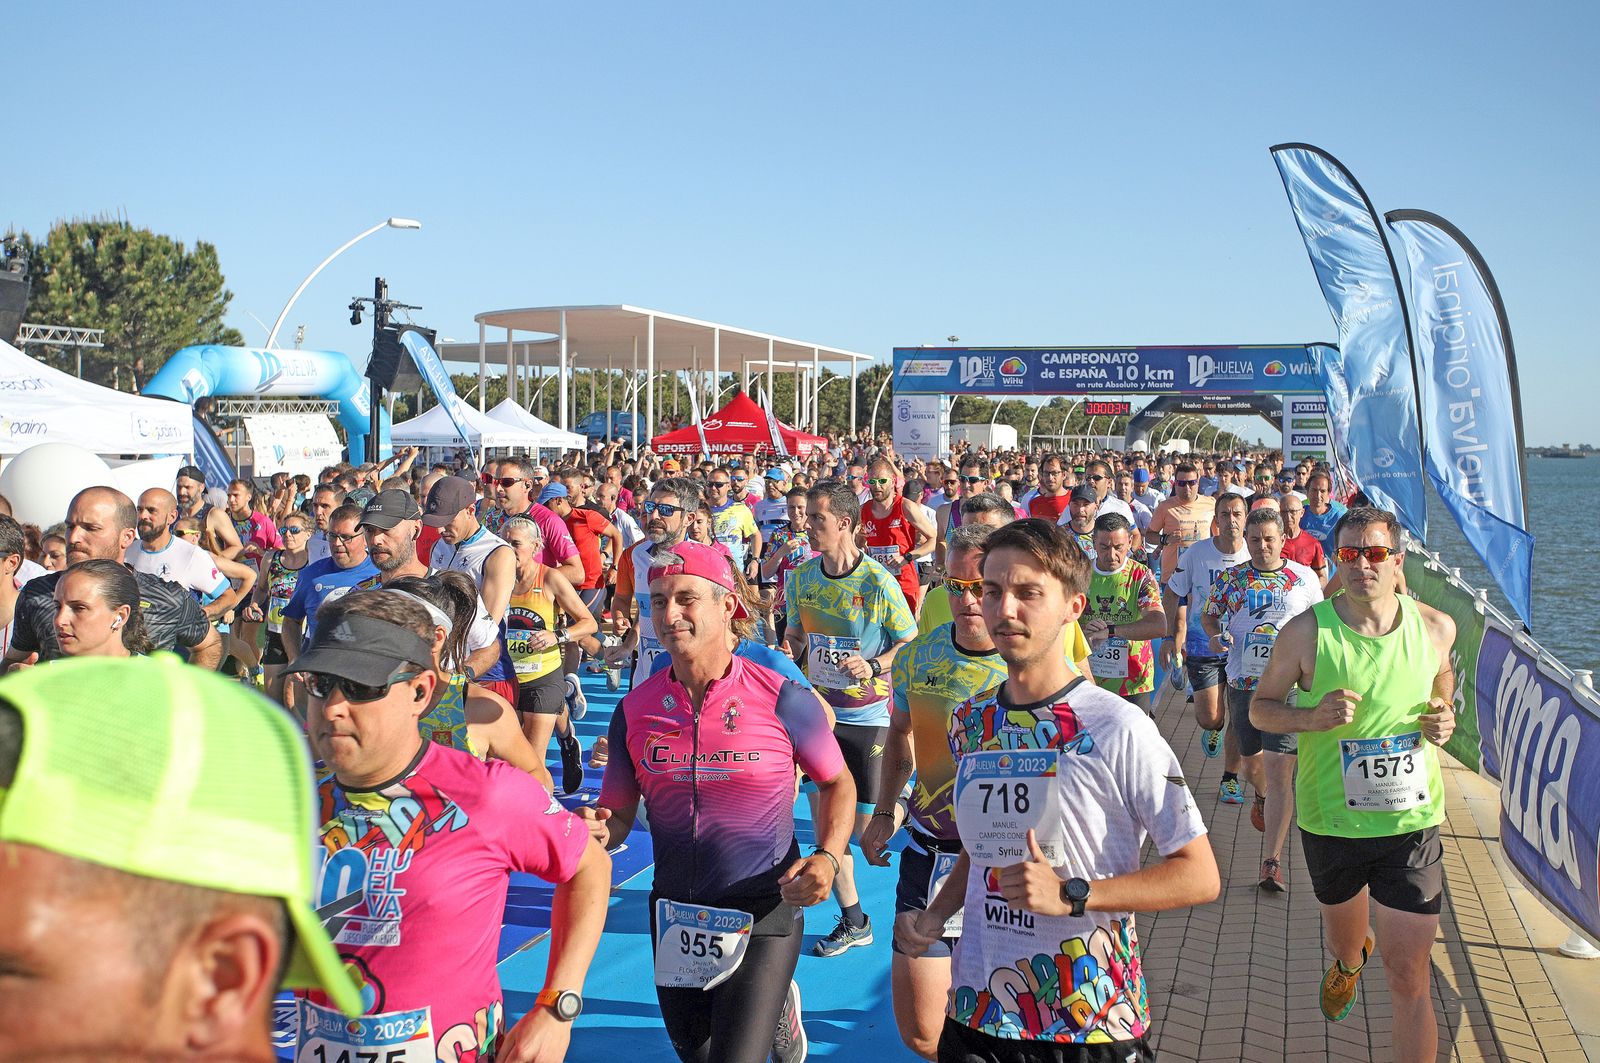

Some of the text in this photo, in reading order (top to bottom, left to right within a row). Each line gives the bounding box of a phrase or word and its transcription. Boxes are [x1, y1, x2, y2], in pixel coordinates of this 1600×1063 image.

[1041, 352, 1139, 364] CAMPEONATO
[1040, 364, 1174, 380] de ESPAÑA 10 km
[1213, 361, 1254, 374] HUELVA
[1290, 362, 1319, 375] WiH
[1003, 376, 1023, 385] WiHu
[657, 444, 692, 452] SPORT
[510, 608, 542, 622] ARTAN
[1252, 646, 1274, 658] 12
[976, 760, 997, 770] HUELVA
[1018, 758, 1048, 772] 2023
[1358, 754, 1414, 779] 1573
[673, 773, 730, 782] CARTAYA
[978, 782, 1030, 814] 718
[992, 822, 1018, 830] MANUEL
[978, 832, 1028, 840] CAMPOS CONE
[675, 910, 696, 920] HUELVA
[984, 903, 1035, 928] WiHu
[714, 915, 742, 928] 2023
[986, 924, 1008, 932] INTERNET
[680, 929, 724, 960] 955
[318, 1020, 344, 1032] HUELVA
[374, 1018, 416, 1041] 2023
